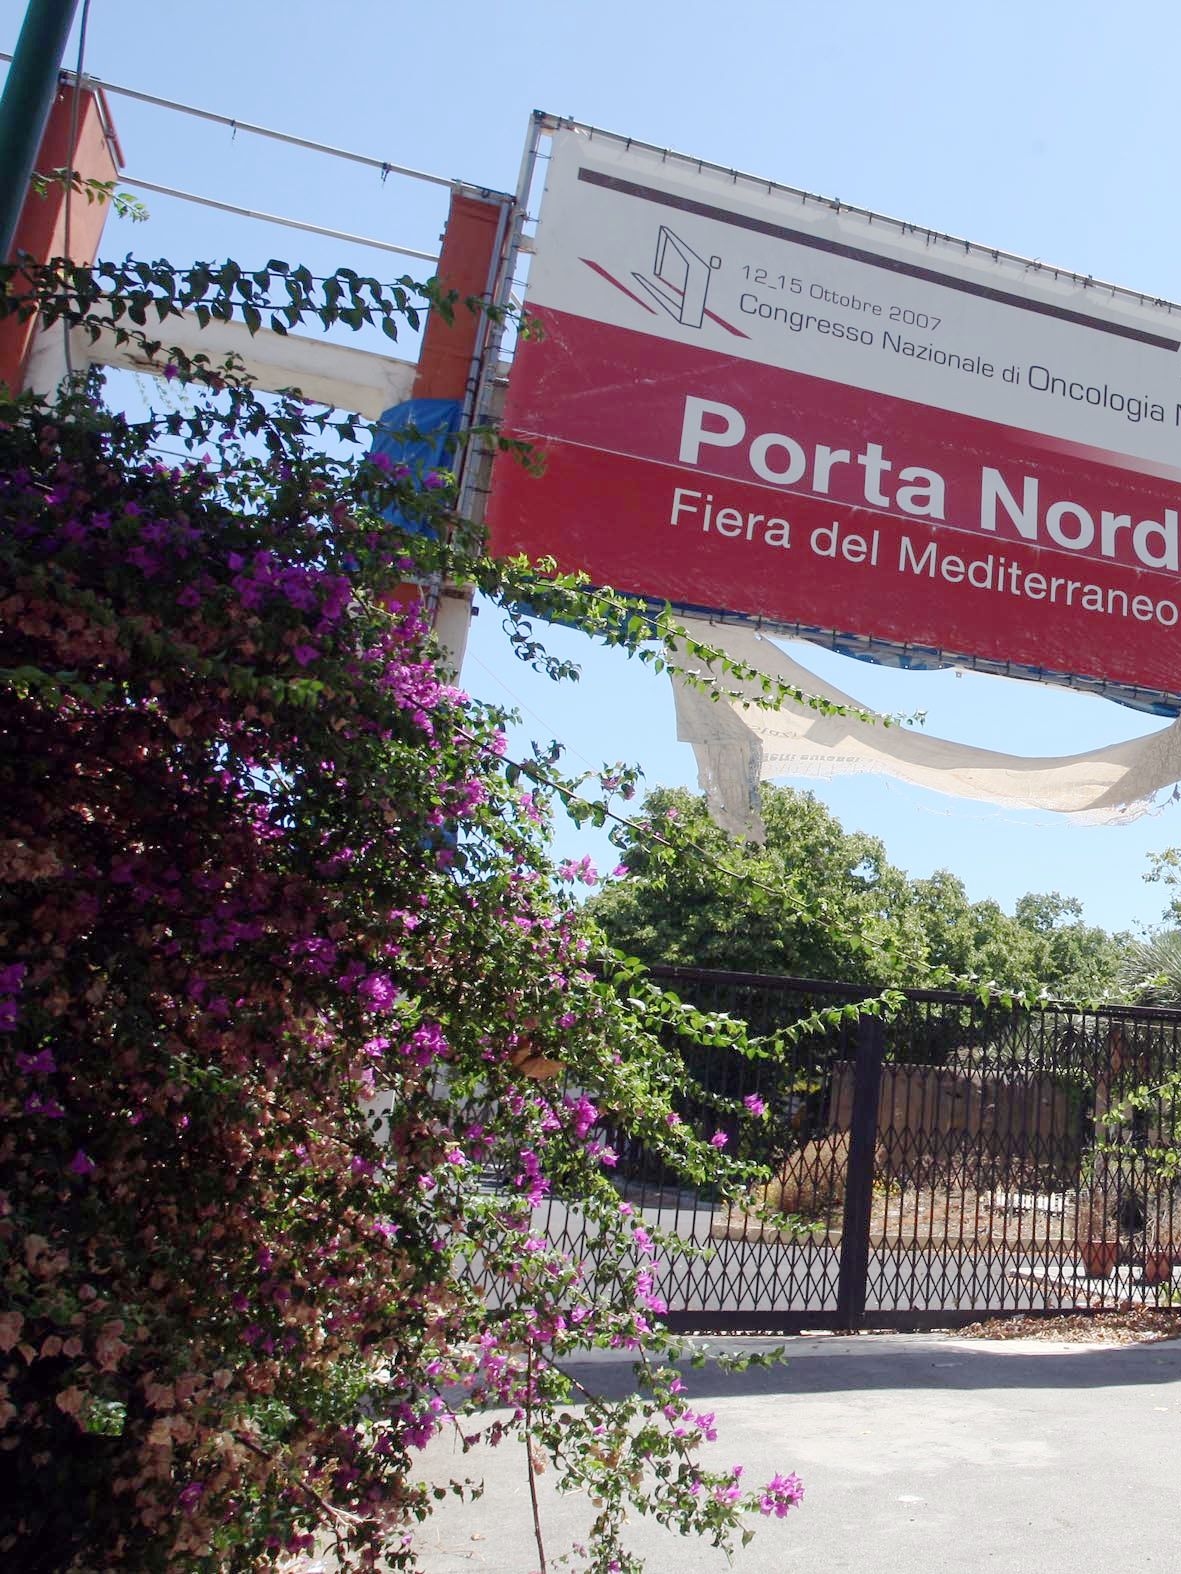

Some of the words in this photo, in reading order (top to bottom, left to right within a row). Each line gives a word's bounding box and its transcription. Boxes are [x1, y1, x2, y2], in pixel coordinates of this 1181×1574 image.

[739, 292, 874, 333] Congresso
[881, 330, 995, 378] Nazionale
[1001, 365, 1021, 385] di
[1028, 364, 1165, 423] Oncologia
[741, 264, 803, 294] 12_15
[809, 283, 882, 317] Ottobre
[888, 305, 942, 332] 2007
[678, 394, 947, 521] Porta
[980, 465, 1180, 572] Nord
[670, 487, 792, 549] Fiera
[809, 520, 880, 566] del
[898, 535, 1180, 627] Mediterraneo
